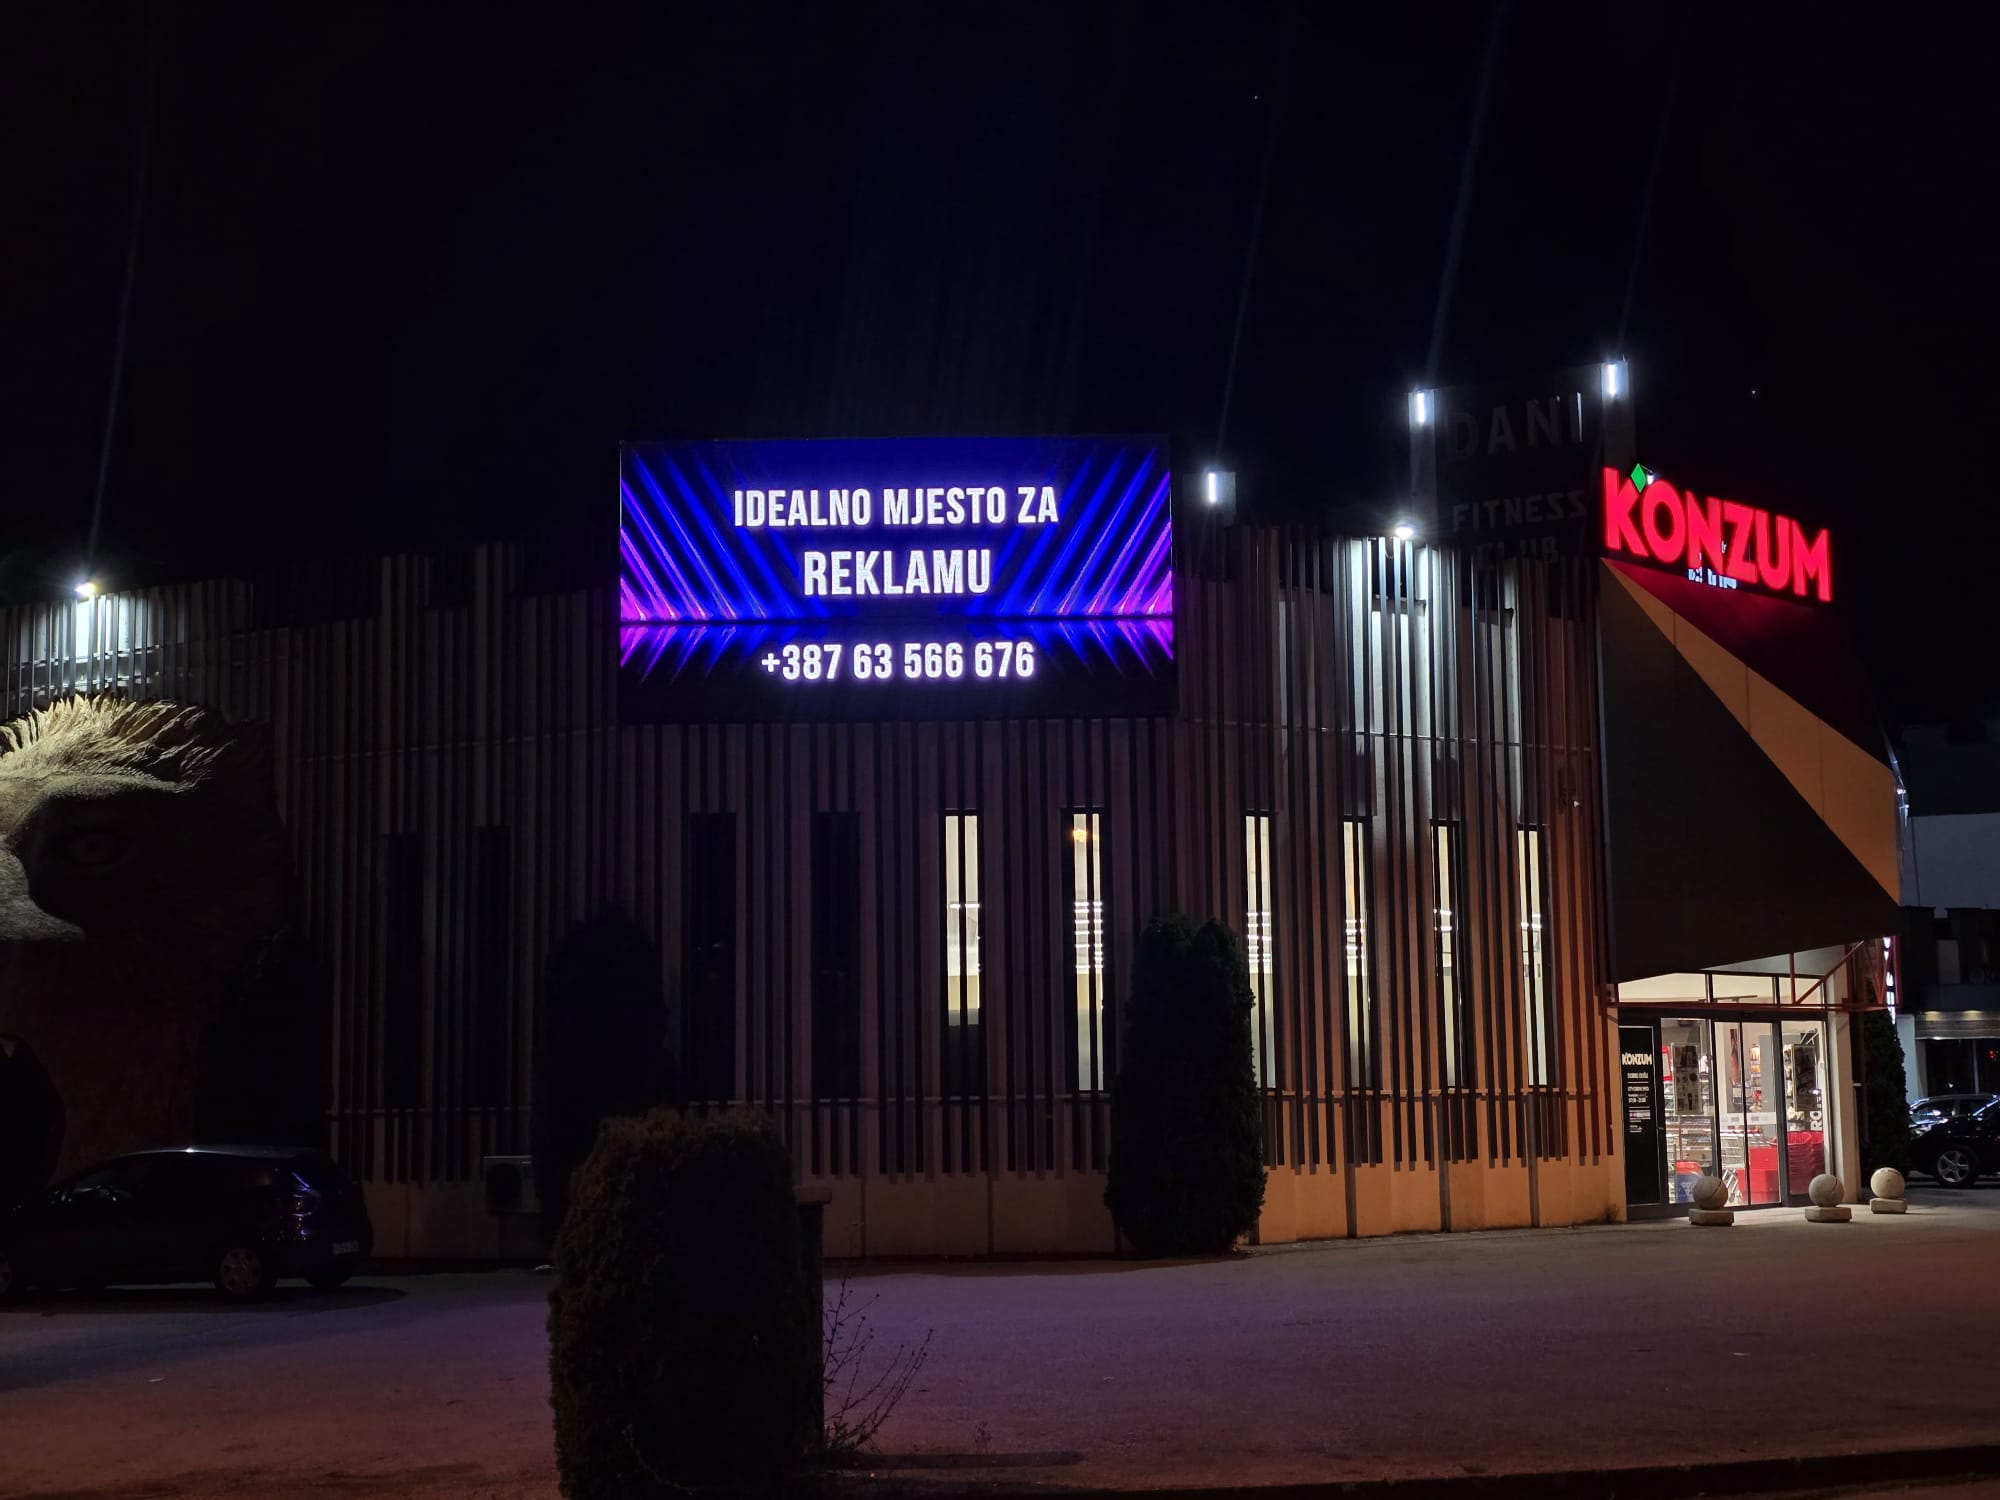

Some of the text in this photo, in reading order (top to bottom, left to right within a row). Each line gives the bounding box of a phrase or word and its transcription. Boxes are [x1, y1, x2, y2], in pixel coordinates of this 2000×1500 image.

[1448, 392, 1583, 462] DANI
[734, 485, 1059, 527] IDEALNO MJESTO ZA
[1452, 489, 1586, 532] FITNESS
[1602, 466, 1834, 602] KONZUM
[804, 549, 991, 596] REKLAMU
[761, 641, 1034, 680] +387 63 566 676
[1621, 1052, 1653, 1066] KONZUM
